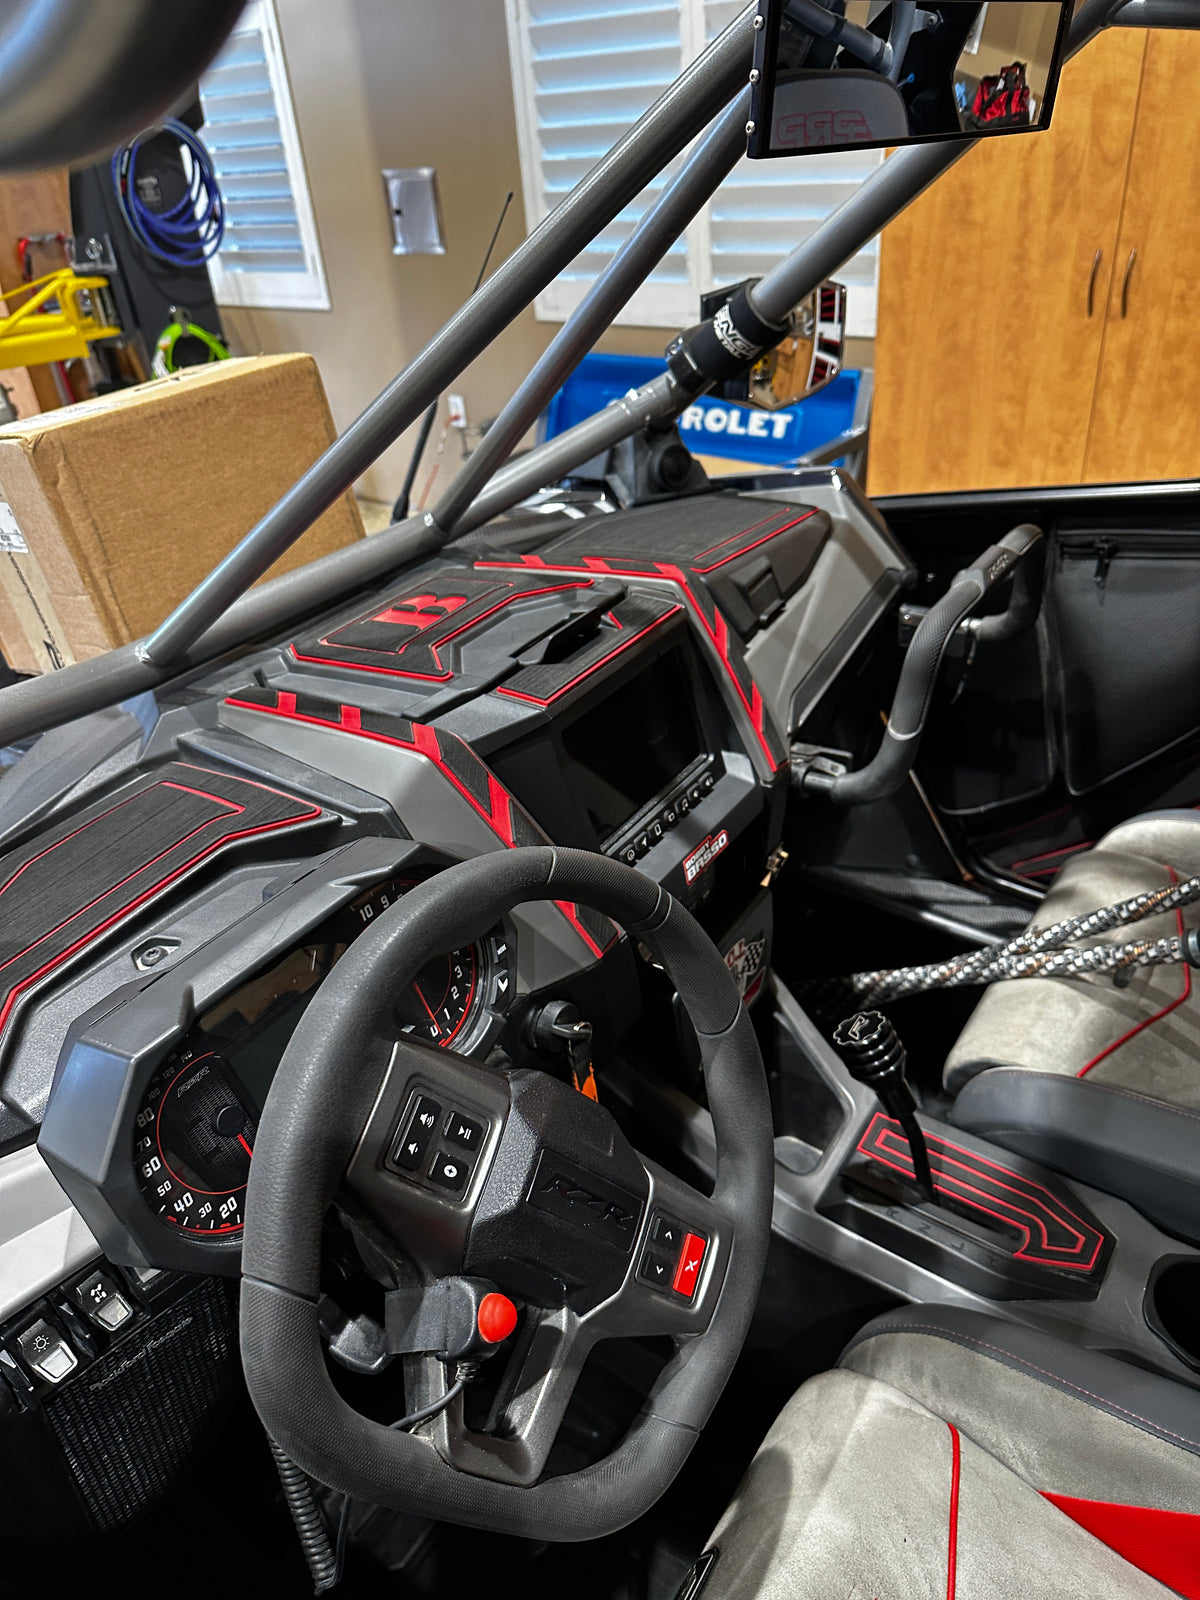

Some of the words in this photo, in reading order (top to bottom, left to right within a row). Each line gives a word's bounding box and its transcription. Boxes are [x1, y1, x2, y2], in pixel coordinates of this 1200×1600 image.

[680, 404, 793, 439] ROLET
[687, 833, 727, 881] BASSO
[360, 904, 373, 921] 10
[381, 895, 390, 909] 9
[454, 965, 463, 979] 3
[451, 985, 460, 1000] 2
[444, 1007, 451, 1020] 1
[181, 1050, 193, 1063] 140
[162, 1066, 175, 1079] 120
[147, 1087, 160, 1100] 100
[137, 1107, 154, 1127] 80
[137, 1136, 151, 1151] 70
[142, 1156, 161, 1178] 60
[157, 1180, 172, 1196] 50
[174, 1192, 194, 1212] 40
[199, 1202, 212, 1218] 30
[220, 1197, 237, 1219] 20
